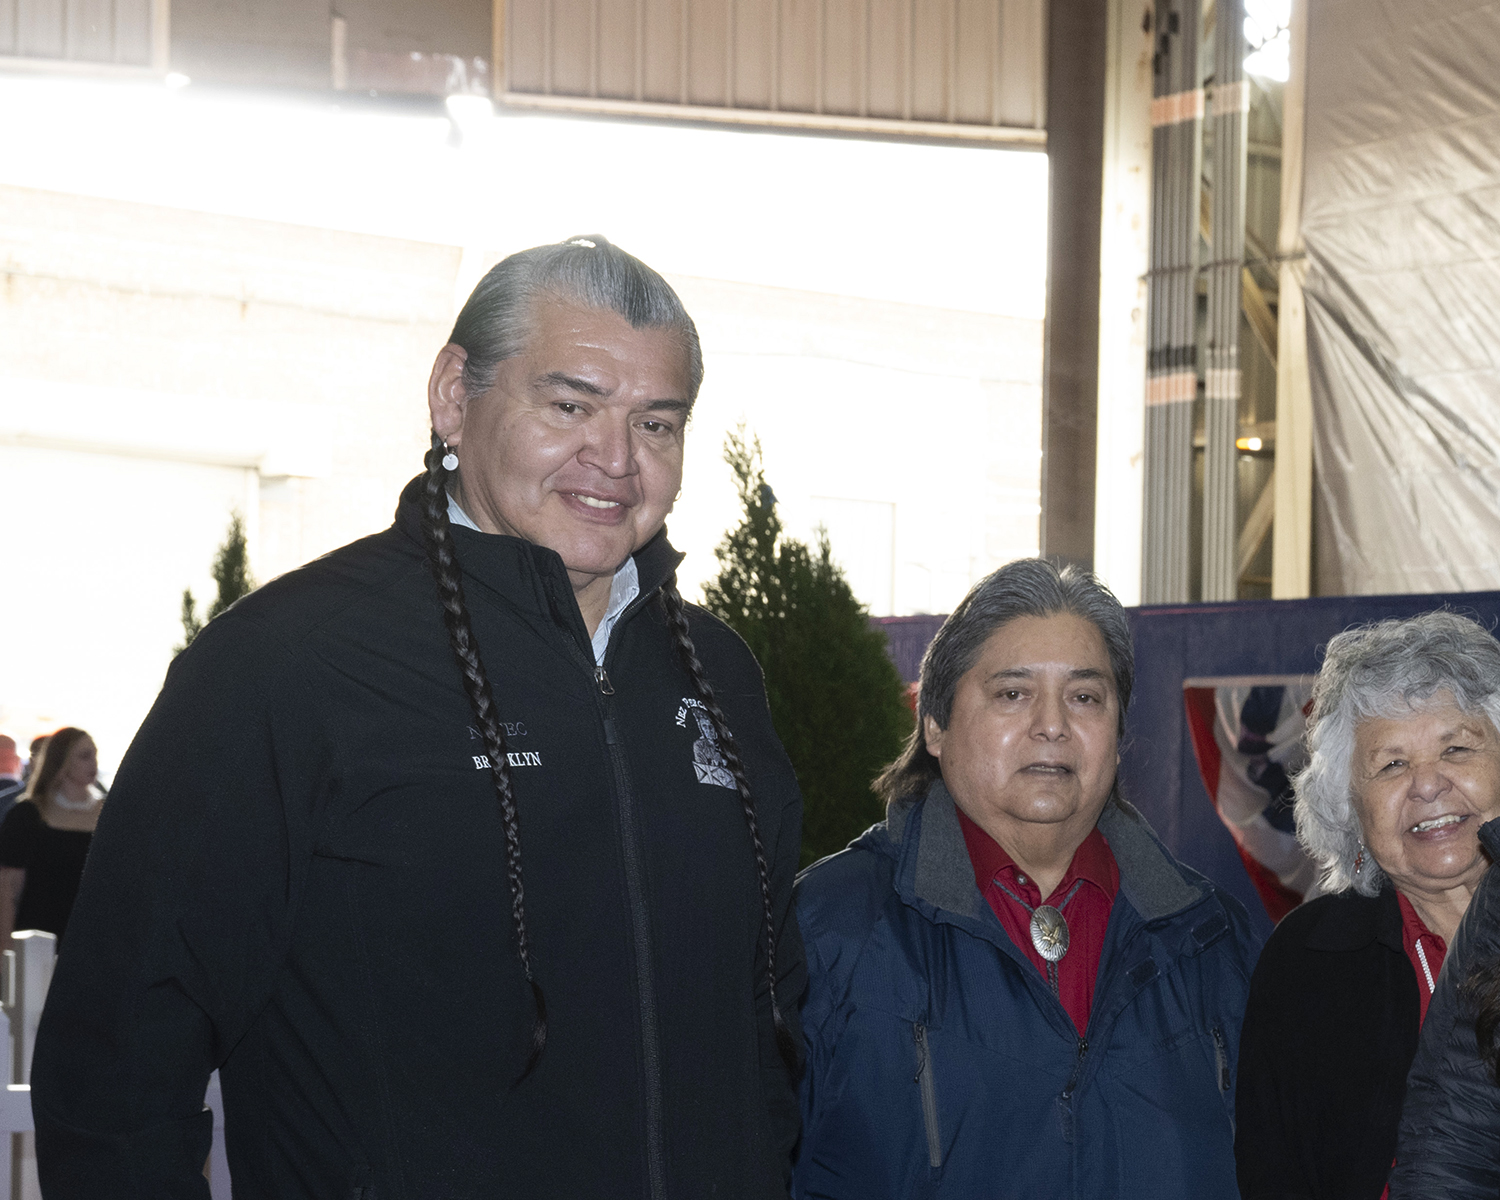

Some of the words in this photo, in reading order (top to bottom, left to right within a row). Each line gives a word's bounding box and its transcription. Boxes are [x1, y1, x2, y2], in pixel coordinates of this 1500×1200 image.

[674, 705, 688, 728] NEZ
[681, 697, 708, 711] PERC
[471, 751, 543, 770] BRKLYN
